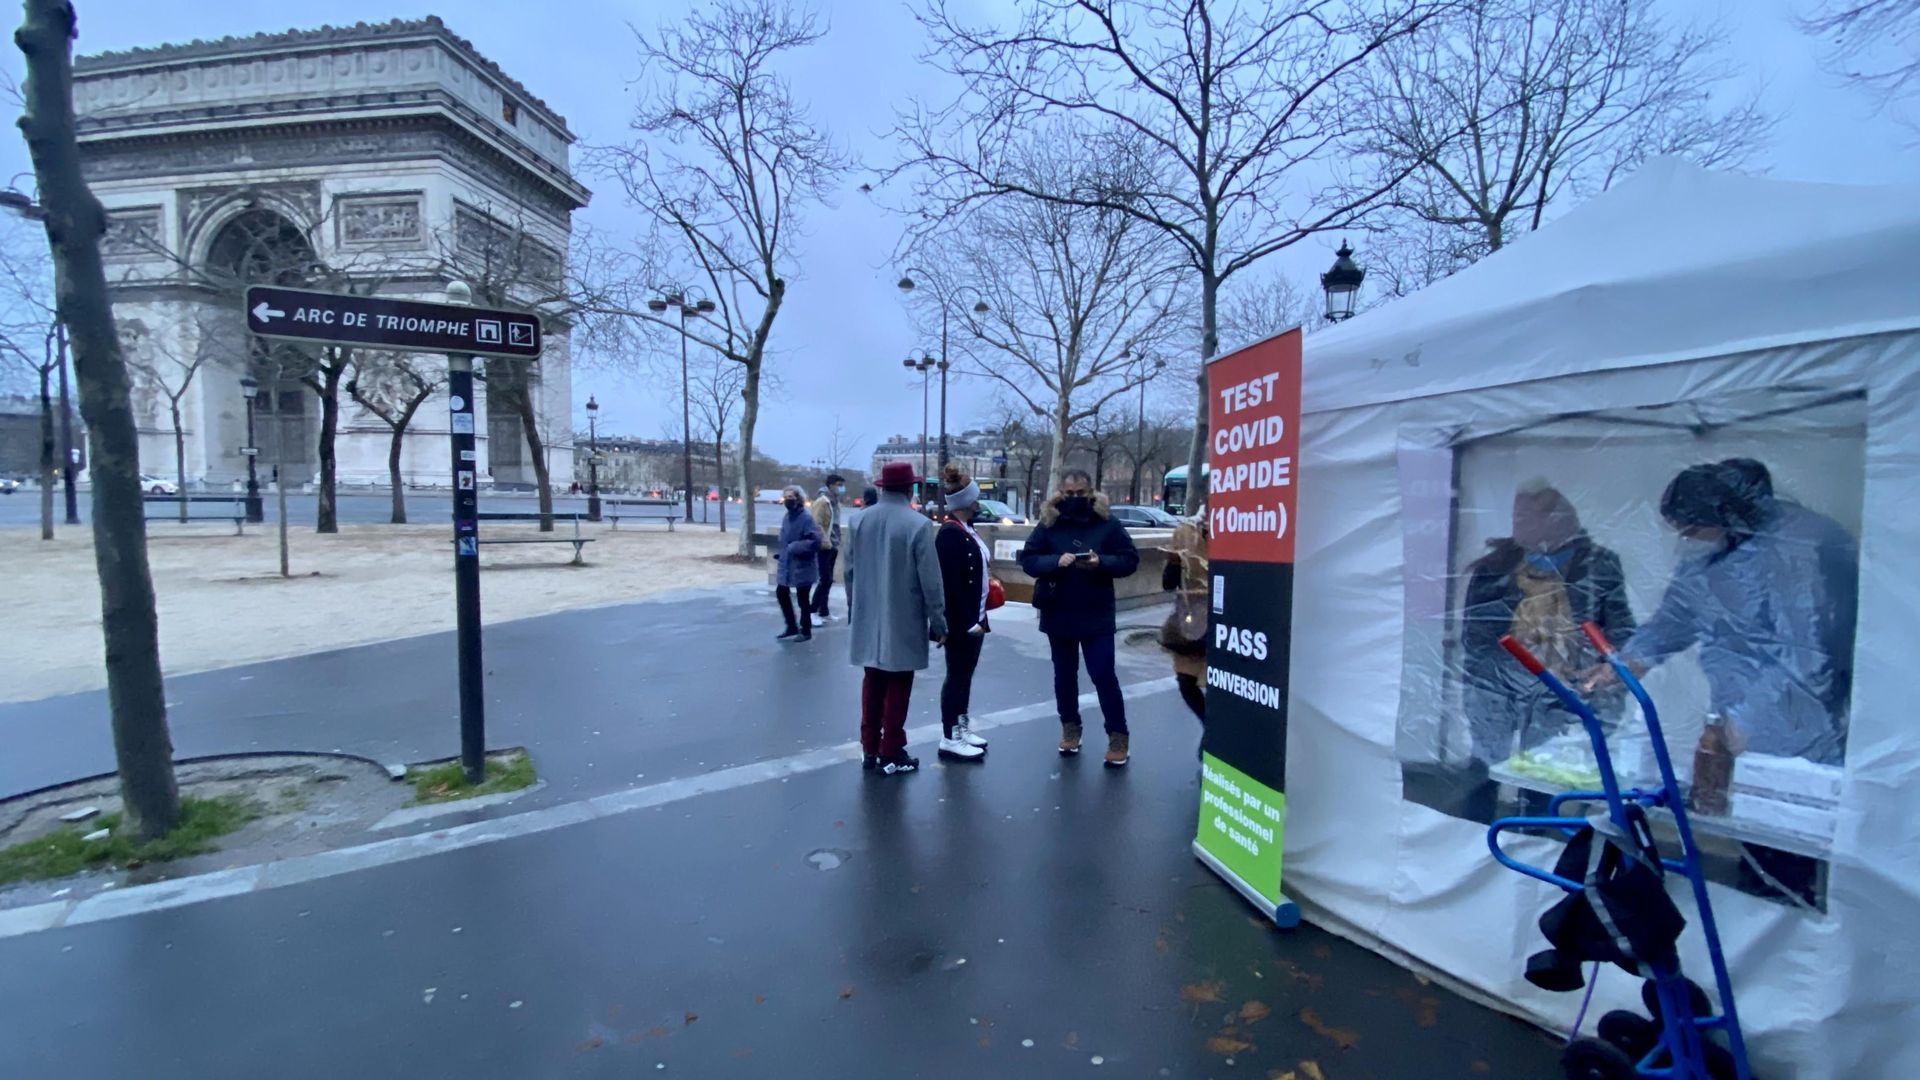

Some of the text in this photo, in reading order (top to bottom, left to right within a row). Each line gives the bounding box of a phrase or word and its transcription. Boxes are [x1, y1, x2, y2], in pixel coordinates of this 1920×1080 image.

[293, 307, 470, 336] ARC DE TRIOMPHE
[1220, 371, 1280, 415] TEST
[1214, 415, 1284, 455] COVID
[1209, 457, 1291, 494] RAPIDE
[1209, 502, 1287, 539] (10min)
[1215, 623, 1268, 661] PASS
[1206, 665, 1280, 710] CONVERSION
[1202, 763, 1280, 822] Réalisés par un
[1204, 789, 1274, 844] professionnel
[1214, 815, 1259, 857] de santé
